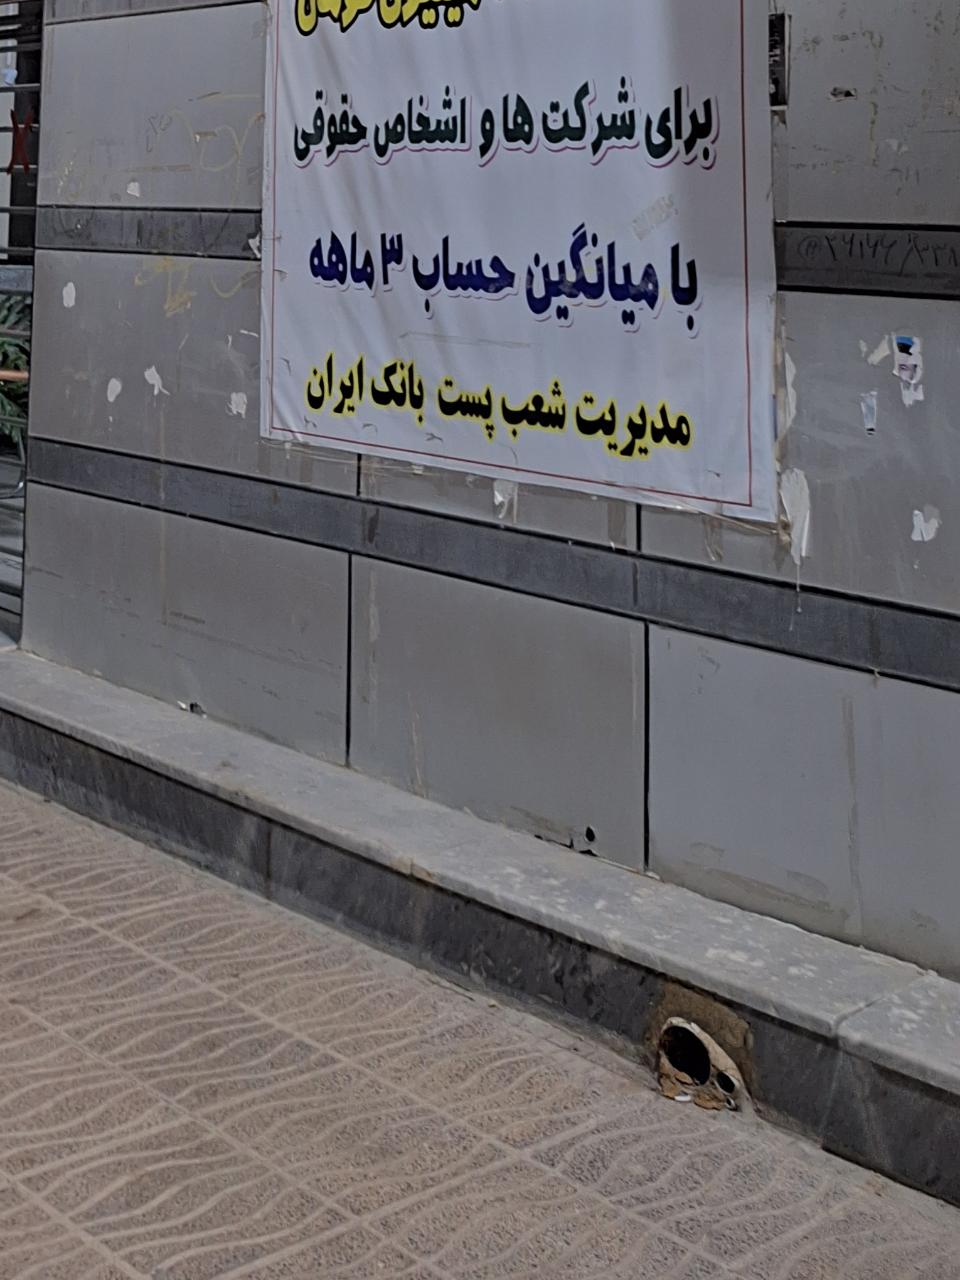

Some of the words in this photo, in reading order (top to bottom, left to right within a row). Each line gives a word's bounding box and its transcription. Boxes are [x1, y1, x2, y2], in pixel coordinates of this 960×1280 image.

[294, 89, 368, 161] حقوقی
[373, 85, 467, 158] اشخاص
[478, 109, 493, 158] و
[542, 76, 637, 158] شرکت
[645, 86, 715, 161] برای
[308, 231, 375, 290] ماهه
[381, 232, 403, 288] ۳
[412, 235, 516, 312] حساب
[526, 223, 658, 325] میانگین
[669, 243, 698, 330] با
[306, 352, 364, 417] ایران
[370, 361, 425, 423] بانک
[438, 373, 495, 439] پست
[501, 379, 566, 438] شعب
[575, 393, 692, 457] مدیریت
